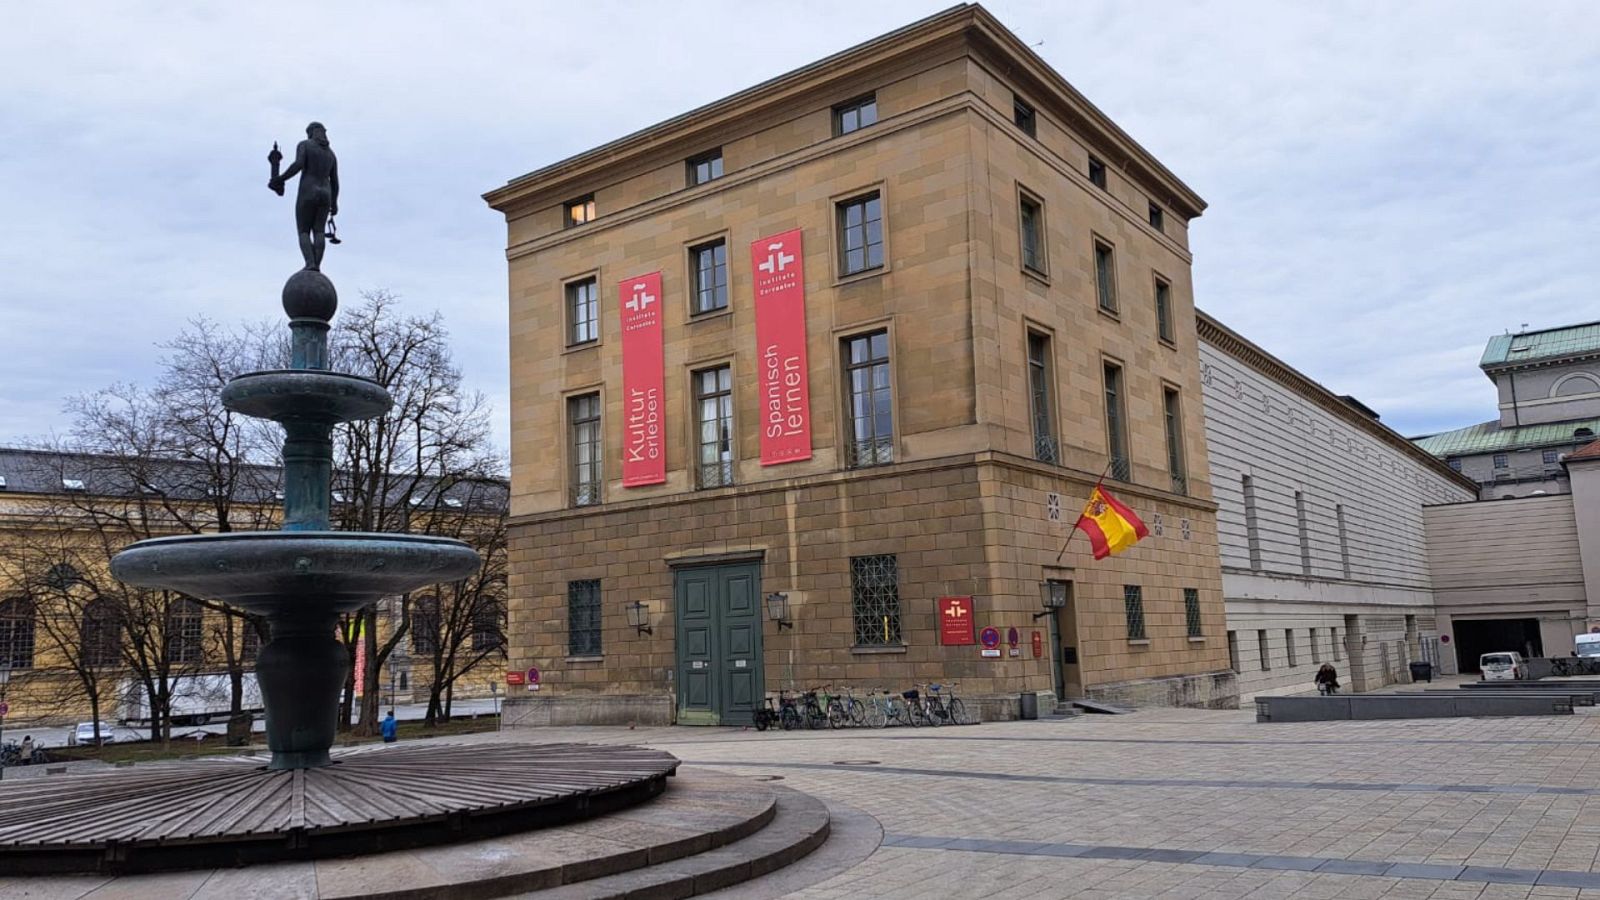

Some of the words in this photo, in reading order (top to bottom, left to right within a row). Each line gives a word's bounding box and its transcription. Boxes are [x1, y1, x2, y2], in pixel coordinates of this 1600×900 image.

[760, 272, 795, 286] Instituto
[760, 282, 796, 296] Cervantes
[629, 388, 645, 462] Kultur
[646, 388, 658, 459] erleben
[764, 344, 784, 438] Spanisch
[784, 356, 803, 436] lernen
